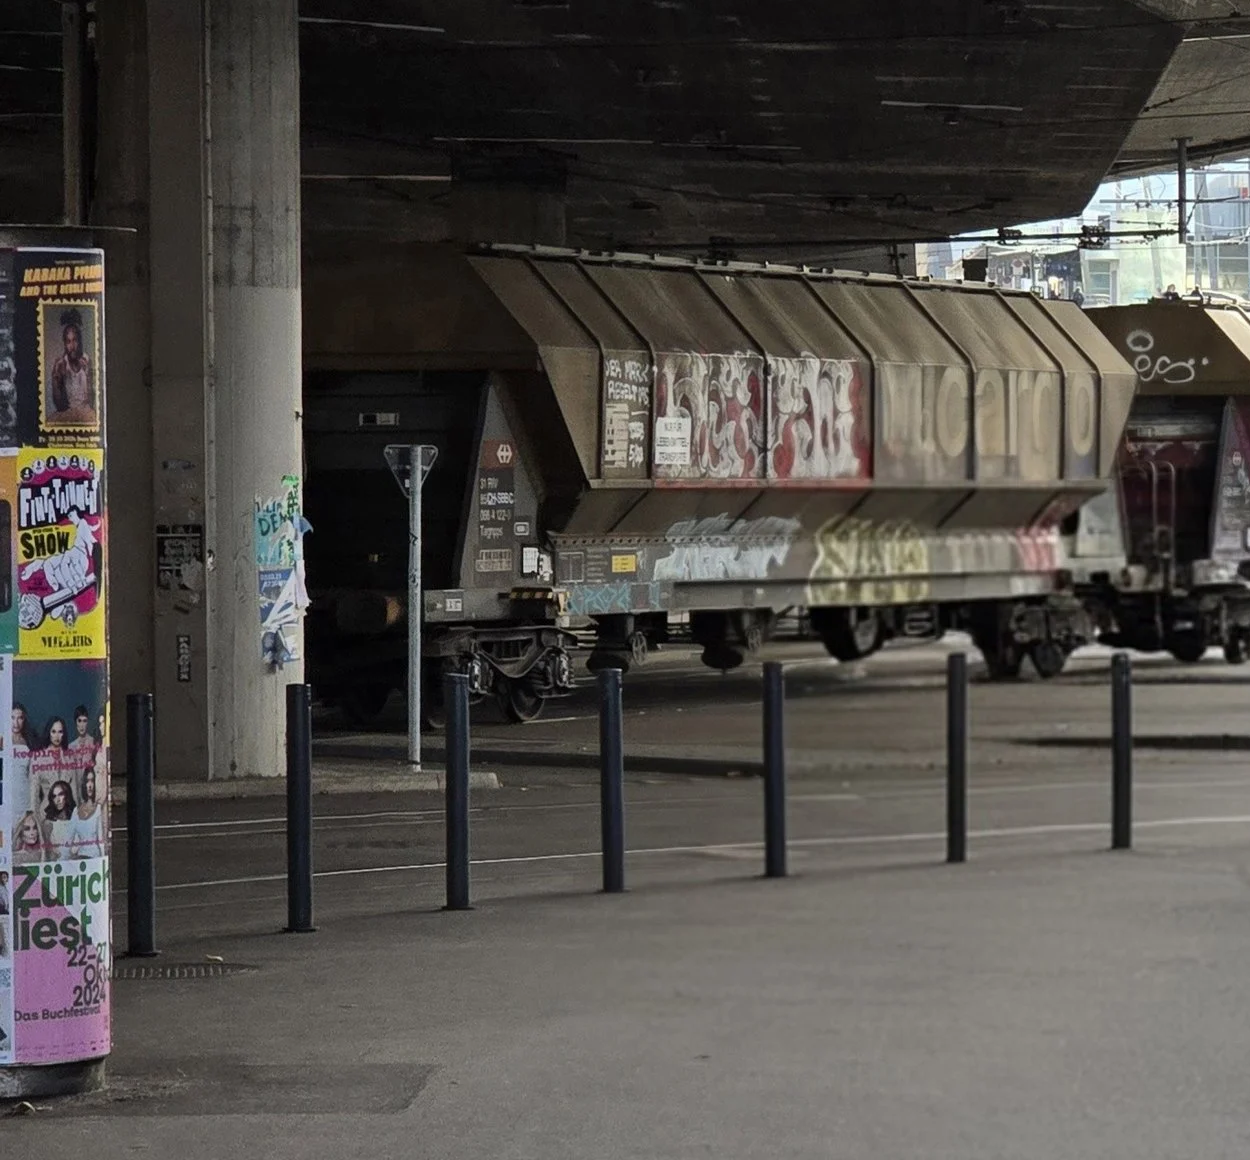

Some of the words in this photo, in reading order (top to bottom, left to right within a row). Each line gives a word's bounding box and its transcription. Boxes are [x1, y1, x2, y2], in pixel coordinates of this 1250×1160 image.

[20, 285, 40, 297] AND
[20, 531, 70, 560] SHOW
[13, 746, 61, 761] keeping
[13, 904, 93, 952] liest
[72, 984, 107, 1007] 2024
[14, 1009, 39, 1023] Das
